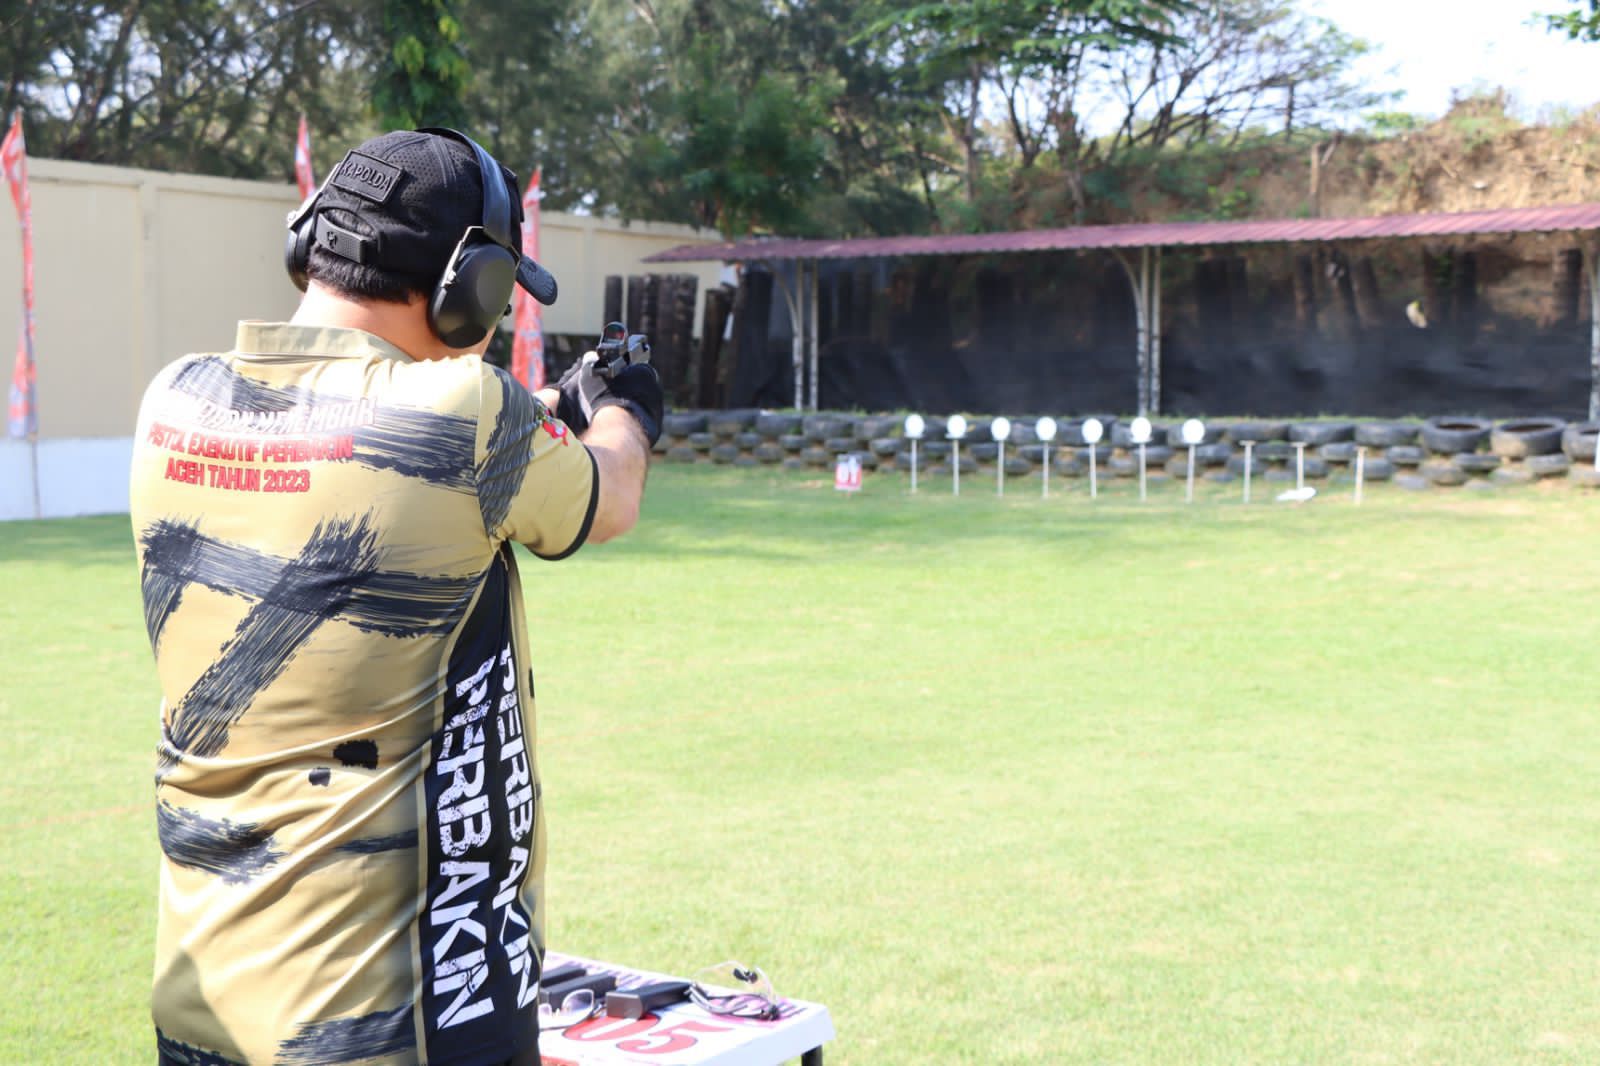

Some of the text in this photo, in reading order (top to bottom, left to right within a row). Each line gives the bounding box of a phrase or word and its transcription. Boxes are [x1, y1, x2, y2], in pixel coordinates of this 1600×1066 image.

[340, 160, 393, 193] KAPOLDA
[164, 457, 311, 493] ACEH TAHUN 2023
[430, 655, 496, 1031] PERBAKIN
